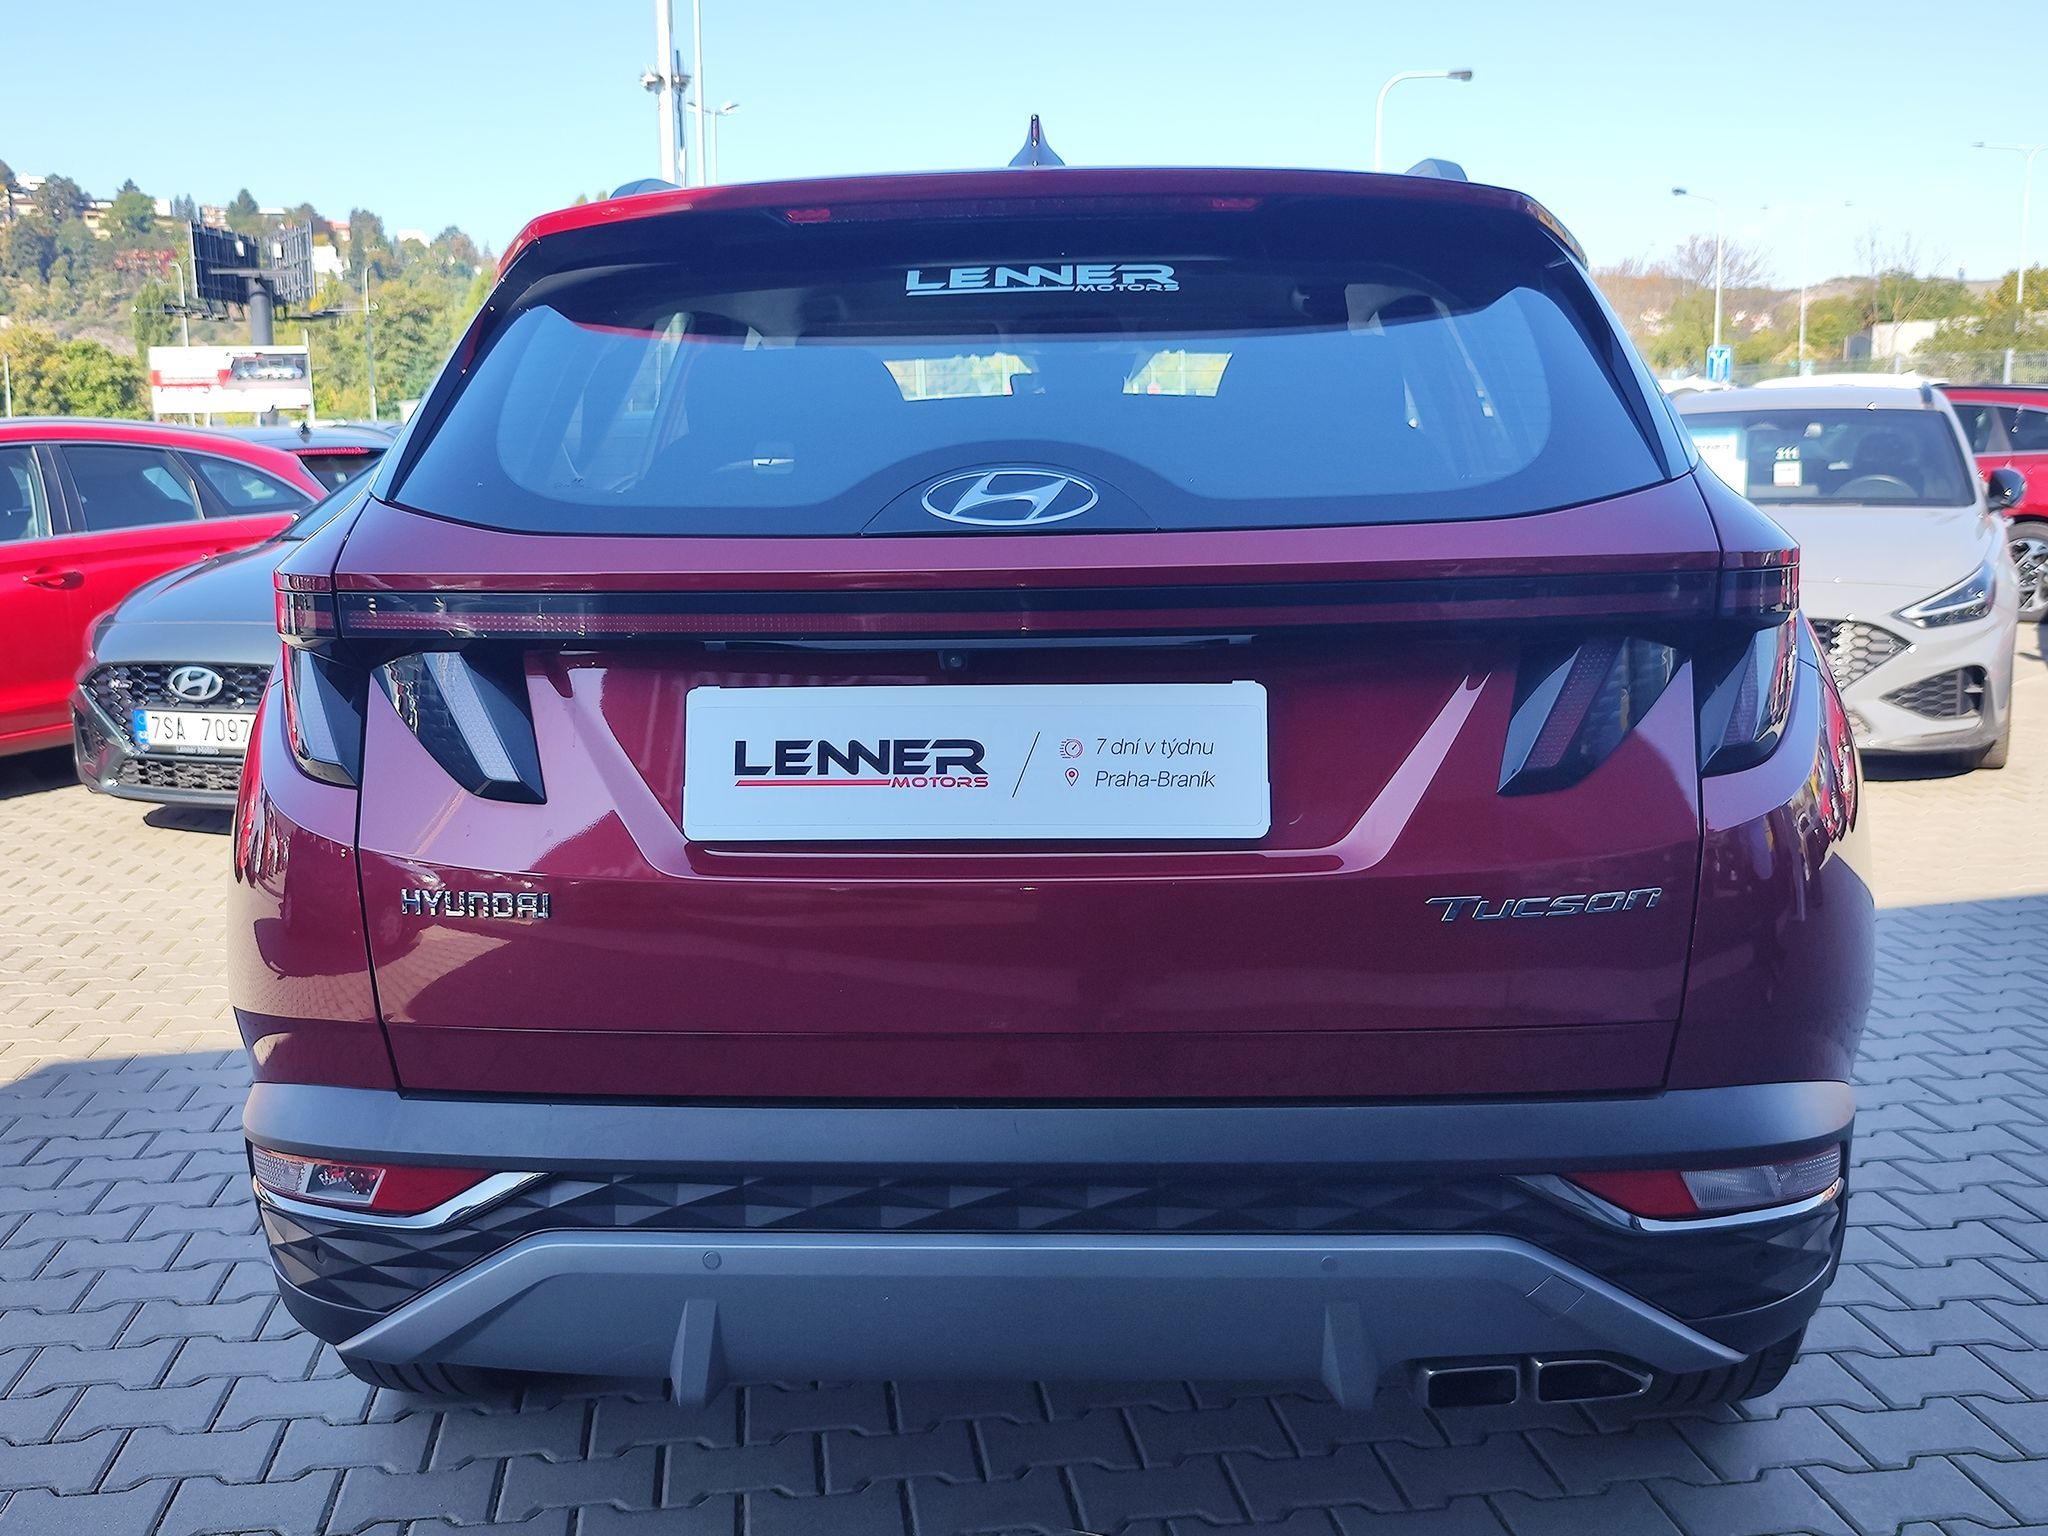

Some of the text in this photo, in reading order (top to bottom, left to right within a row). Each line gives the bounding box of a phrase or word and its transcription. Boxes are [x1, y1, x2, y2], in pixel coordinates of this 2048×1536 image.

[906, 264, 1180, 291] LENNER
[1074, 283, 1181, 293] MOTORS
[150, 715, 250, 743] 7SA 7097
[733, 739, 989, 776] LENNER
[1096, 737, 1215, 759] 7 dní v týdnu
[891, 776, 989, 788] MOTORS
[1094, 769, 1217, 788] Praha-Braník
[401, 888, 551, 919] HYUNDAI
